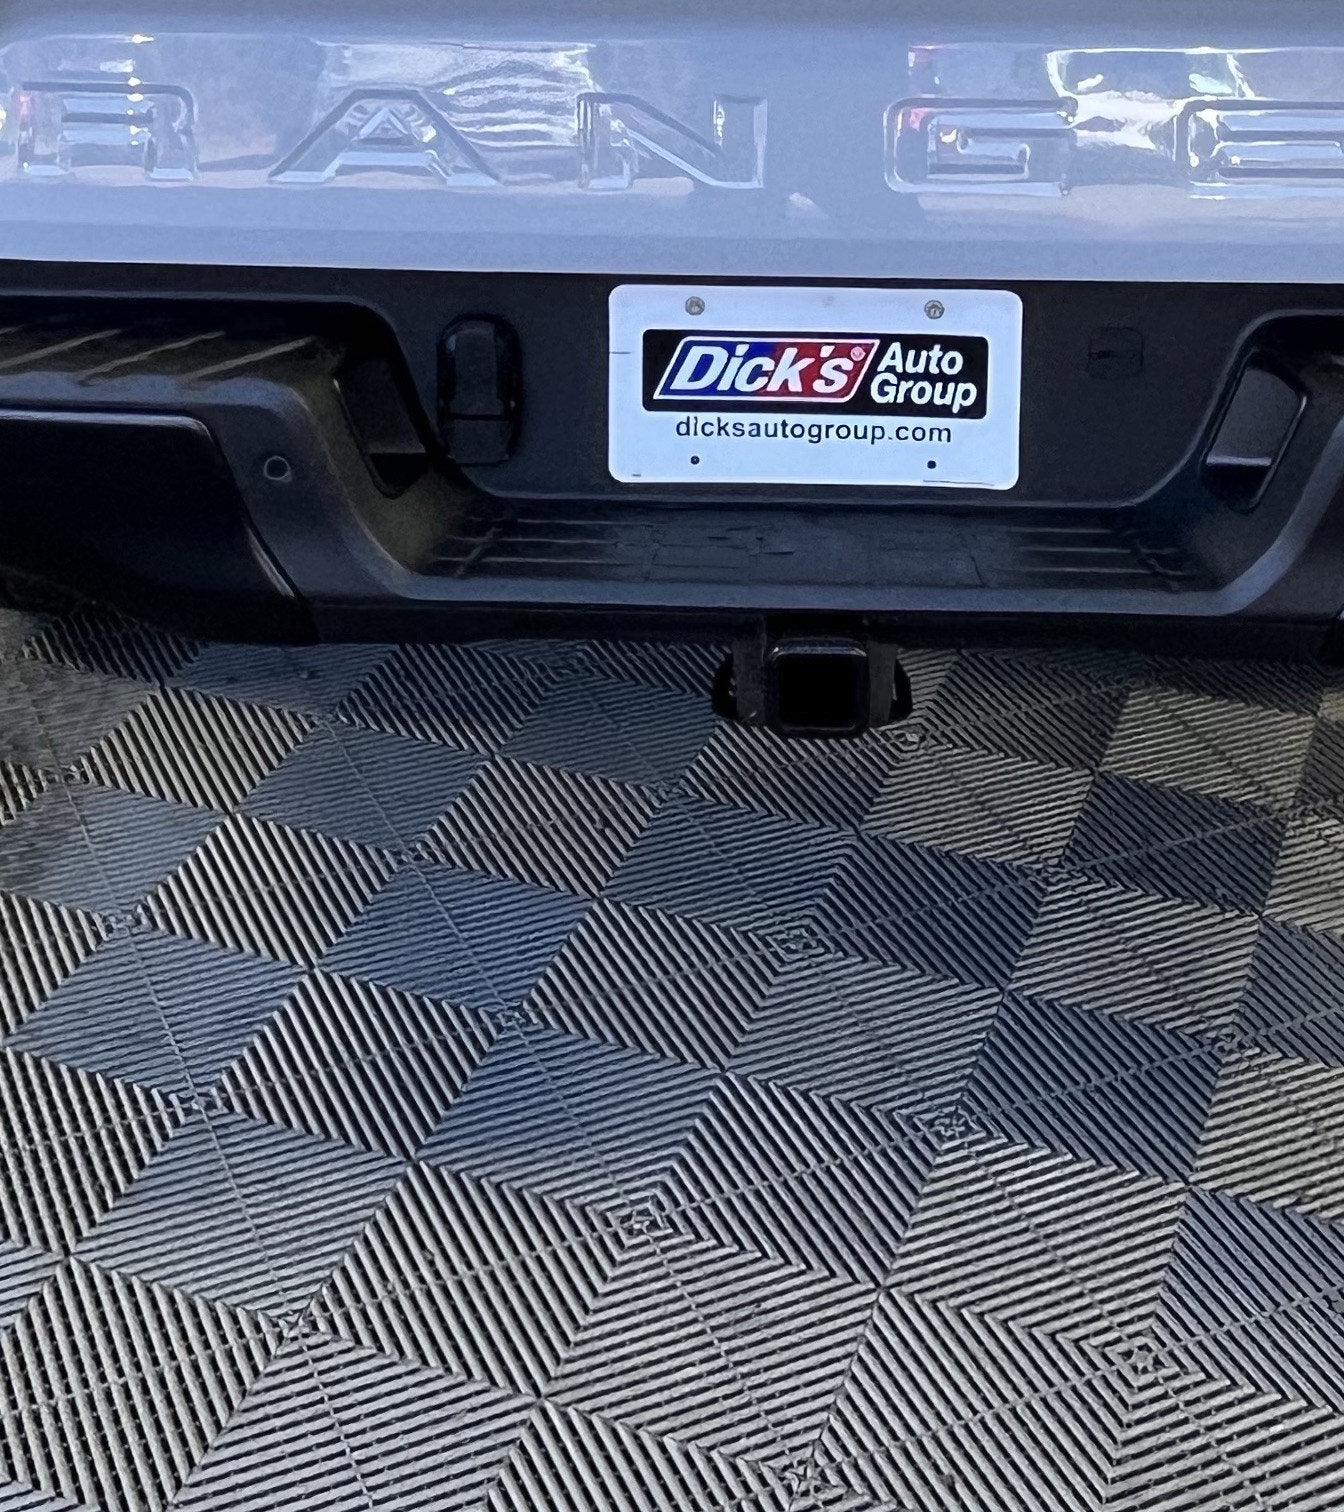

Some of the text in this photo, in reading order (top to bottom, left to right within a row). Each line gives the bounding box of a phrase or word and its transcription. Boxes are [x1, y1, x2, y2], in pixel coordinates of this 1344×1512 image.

[877, 341, 963, 375] Auto
[870, 373, 977, 413] Group
[675, 416, 952, 444] dicksautogroup.com
